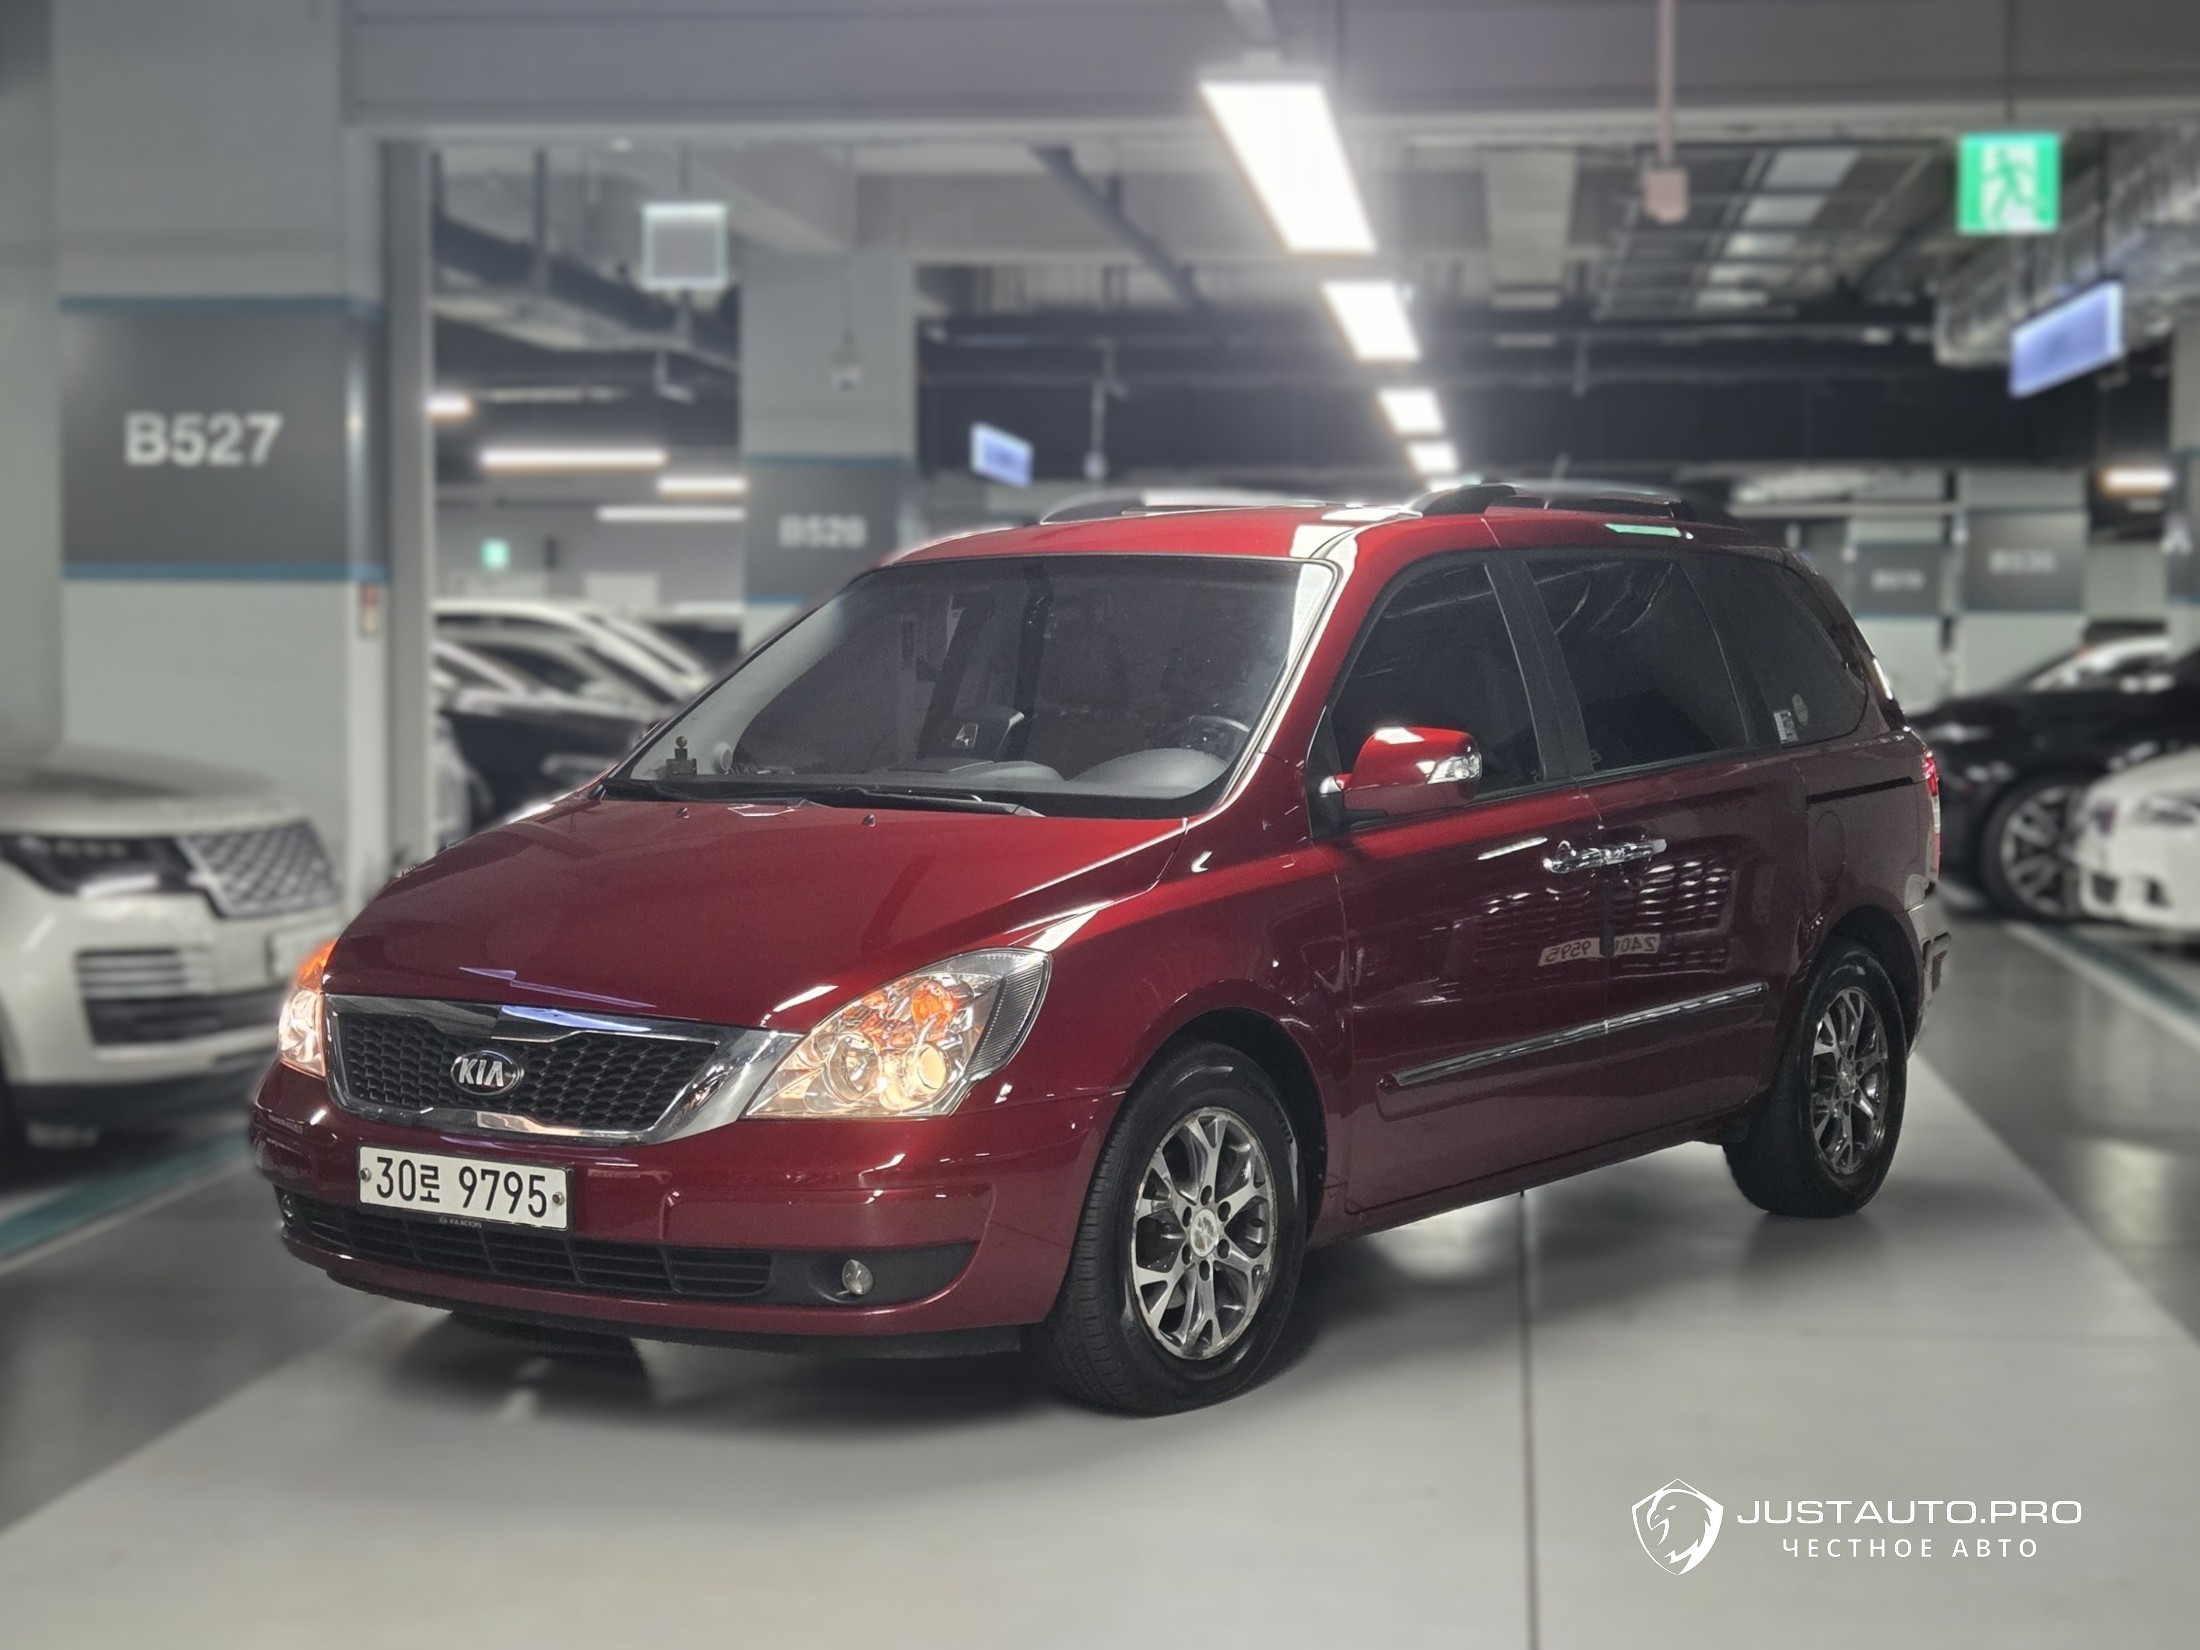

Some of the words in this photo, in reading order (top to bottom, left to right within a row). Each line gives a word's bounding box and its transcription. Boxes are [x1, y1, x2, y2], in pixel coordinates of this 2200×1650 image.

[124, 412, 284, 467] B527
[458, 1058, 504, 1087] KIA
[376, 1156, 440, 1204] 30로
[458, 1165, 548, 1218] 9795
